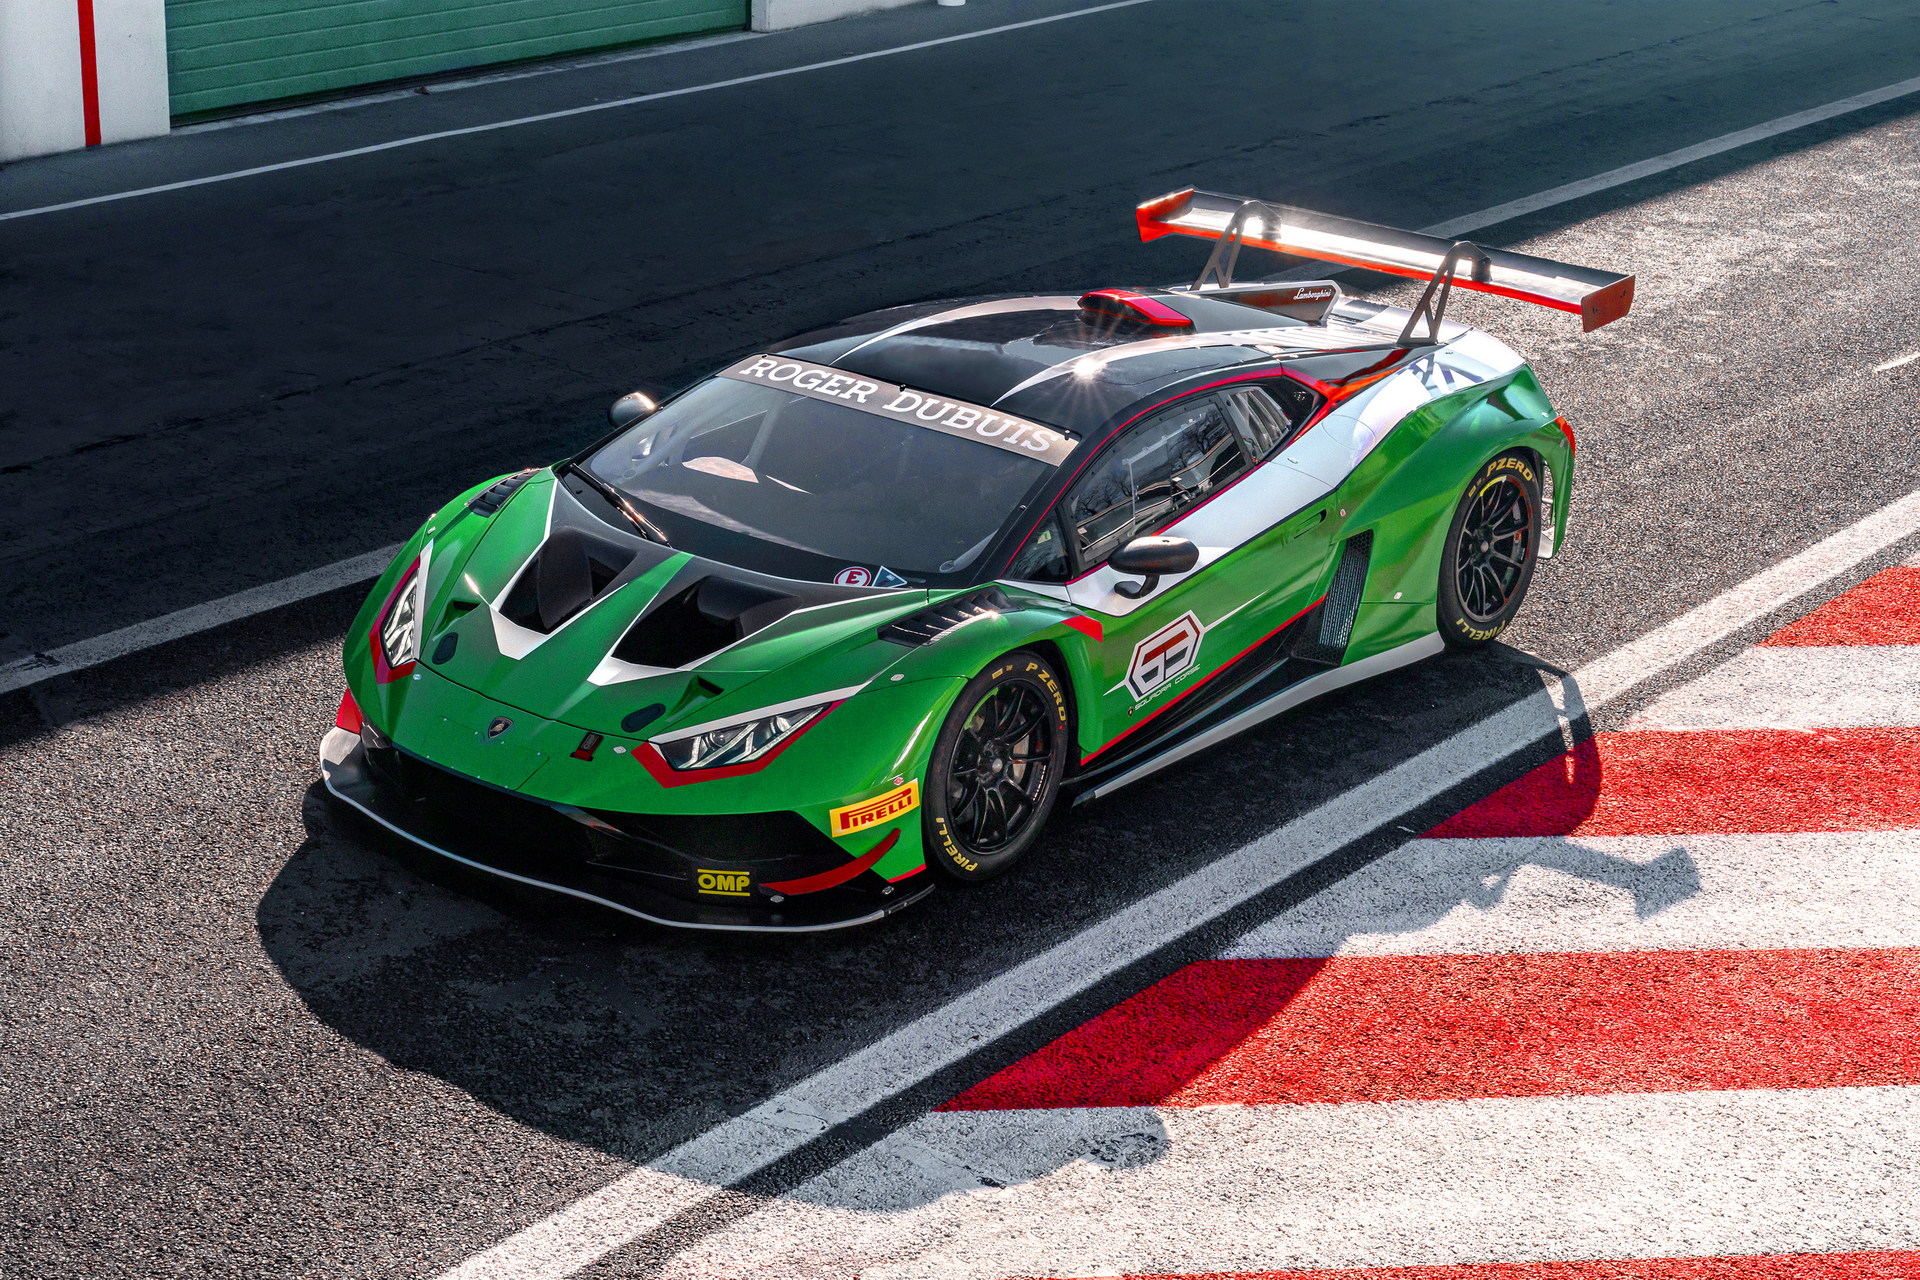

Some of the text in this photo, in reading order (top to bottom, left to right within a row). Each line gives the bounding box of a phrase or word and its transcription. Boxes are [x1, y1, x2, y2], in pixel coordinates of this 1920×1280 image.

[1293, 287, 1332, 300] Lamborghini
[739, 357, 1068, 453] ROGER DUBUIS
[845, 570, 862, 584] E
[839, 787, 912, 830] PIRELLI
[935, 817, 979, 872] PIRELLI
[698, 873, 750, 892] OMP
